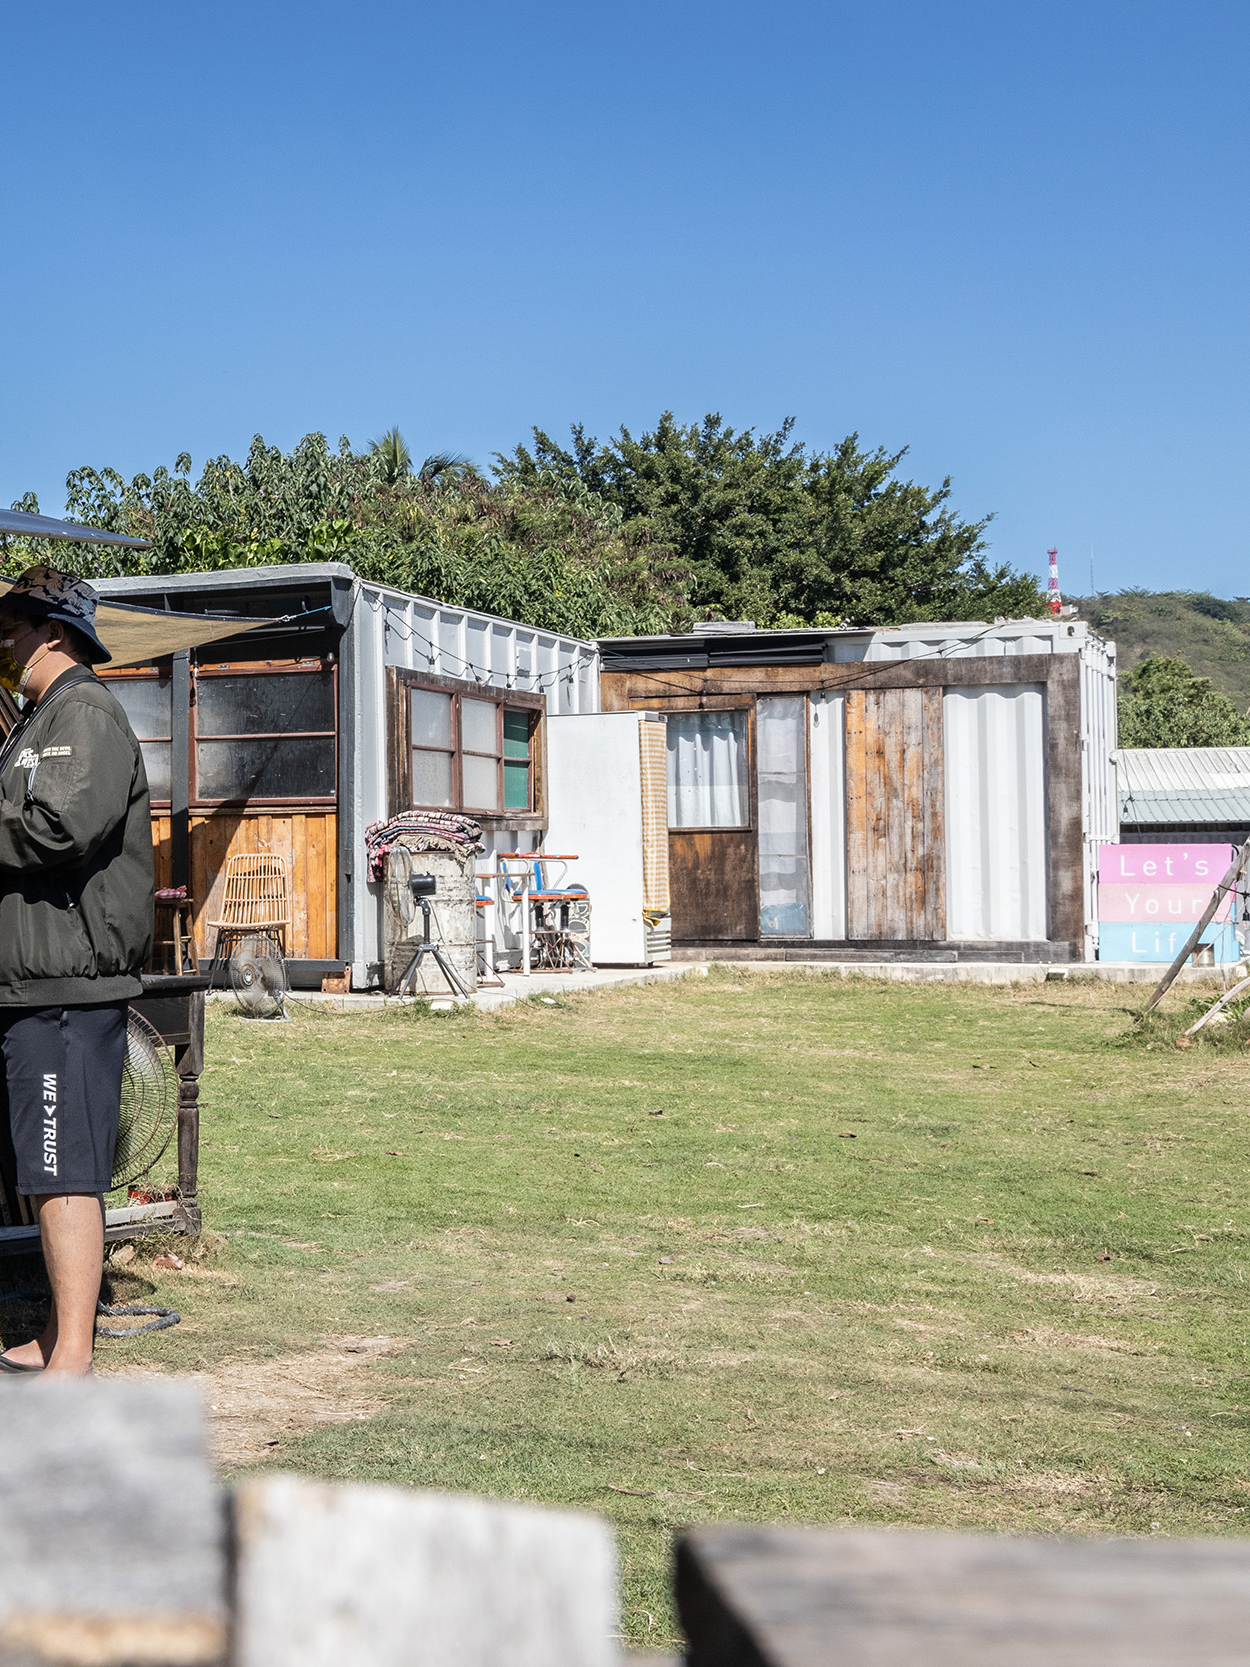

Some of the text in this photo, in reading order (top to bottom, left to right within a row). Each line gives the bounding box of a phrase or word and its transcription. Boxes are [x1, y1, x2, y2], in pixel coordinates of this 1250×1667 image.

[1124, 893, 1204, 915] Your
[1131, 931, 1188, 953] Lif
[43, 1117, 58, 1177] TRUST
